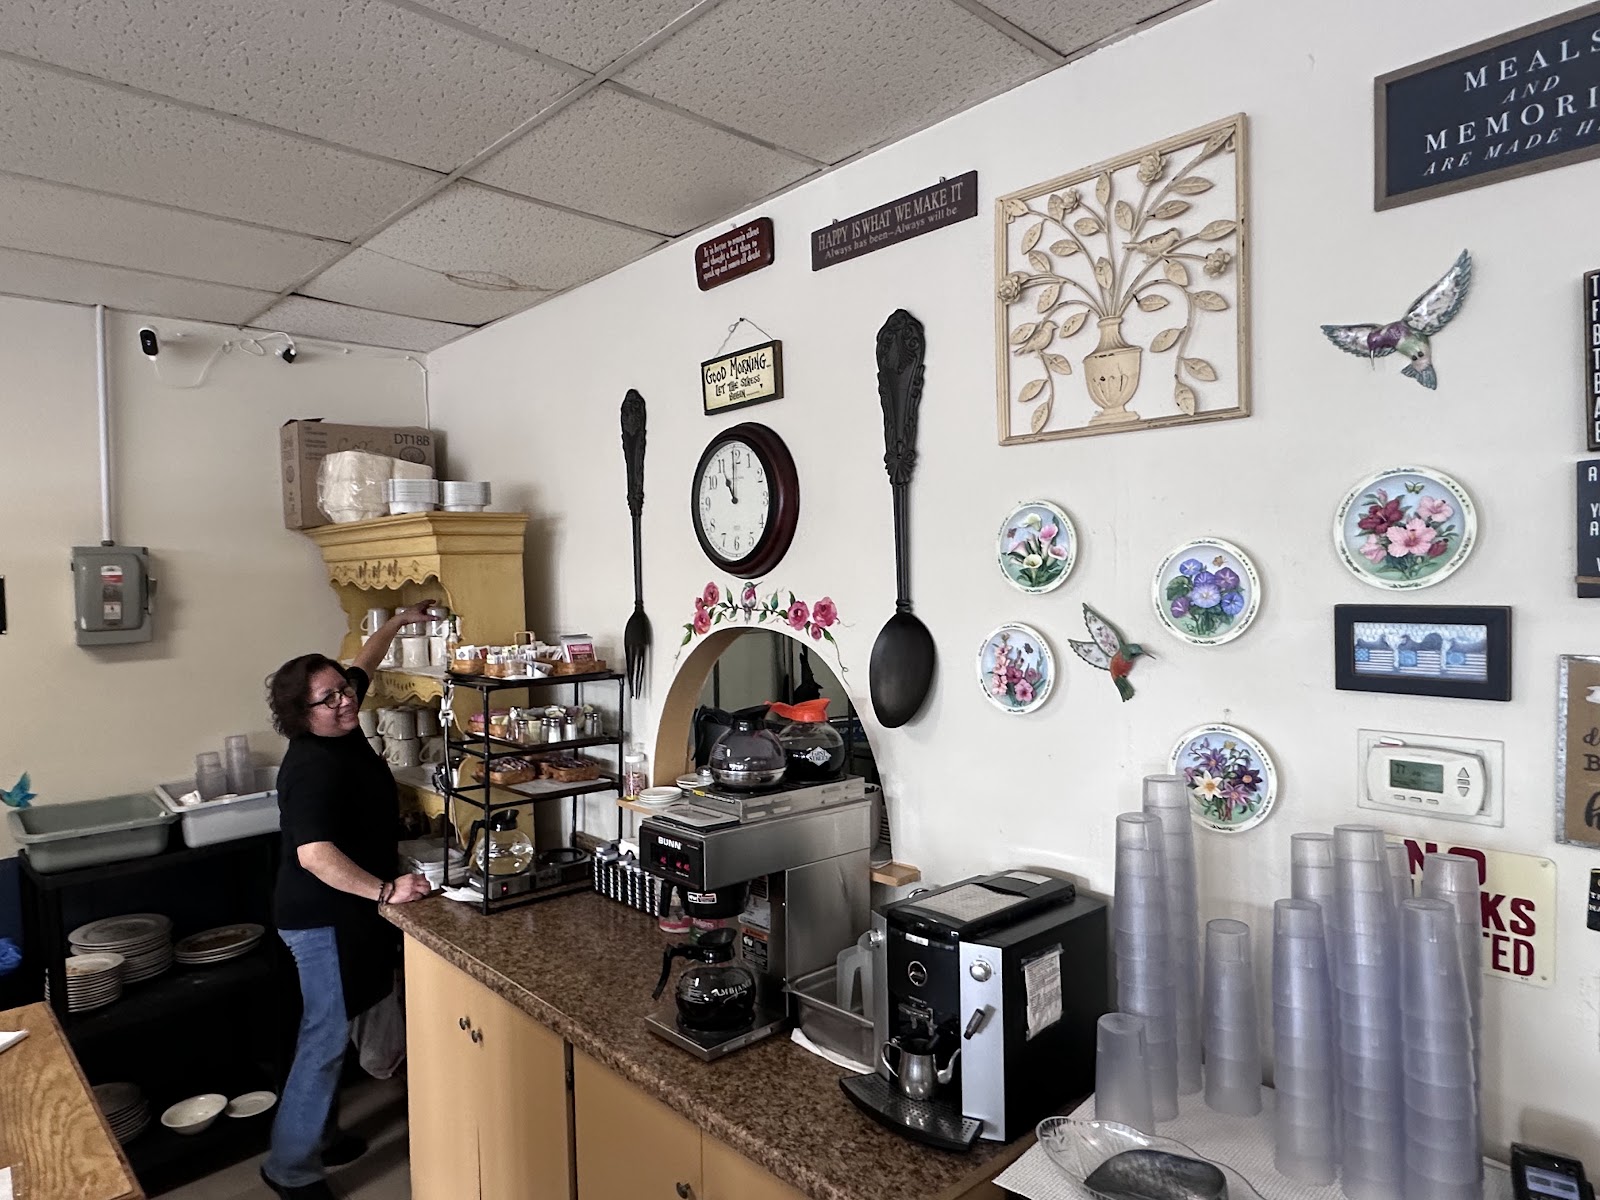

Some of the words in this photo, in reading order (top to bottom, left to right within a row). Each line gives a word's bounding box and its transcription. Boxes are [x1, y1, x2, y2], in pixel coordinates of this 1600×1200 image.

[1502, 75, 1560, 104] AND
[1423, 151, 1473, 177] ARE
[1485, 128, 1562, 160] MADE
[818, 225, 848, 251] HAPPY
[852, 221, 861, 239] IS
[861, 209, 892, 234] WHAT
[894, 202, 912, 222] WE
[913, 188, 947, 217] MAKE
[951, 182, 964, 203] IT
[824, 244, 852, 260] Always
[854, 237, 868, 250] has
[928, 209, 945, 223] will
[946, 205, 958, 218] be
[716, 383, 726, 397] LET
[657, 836, 682, 850] BUNN
